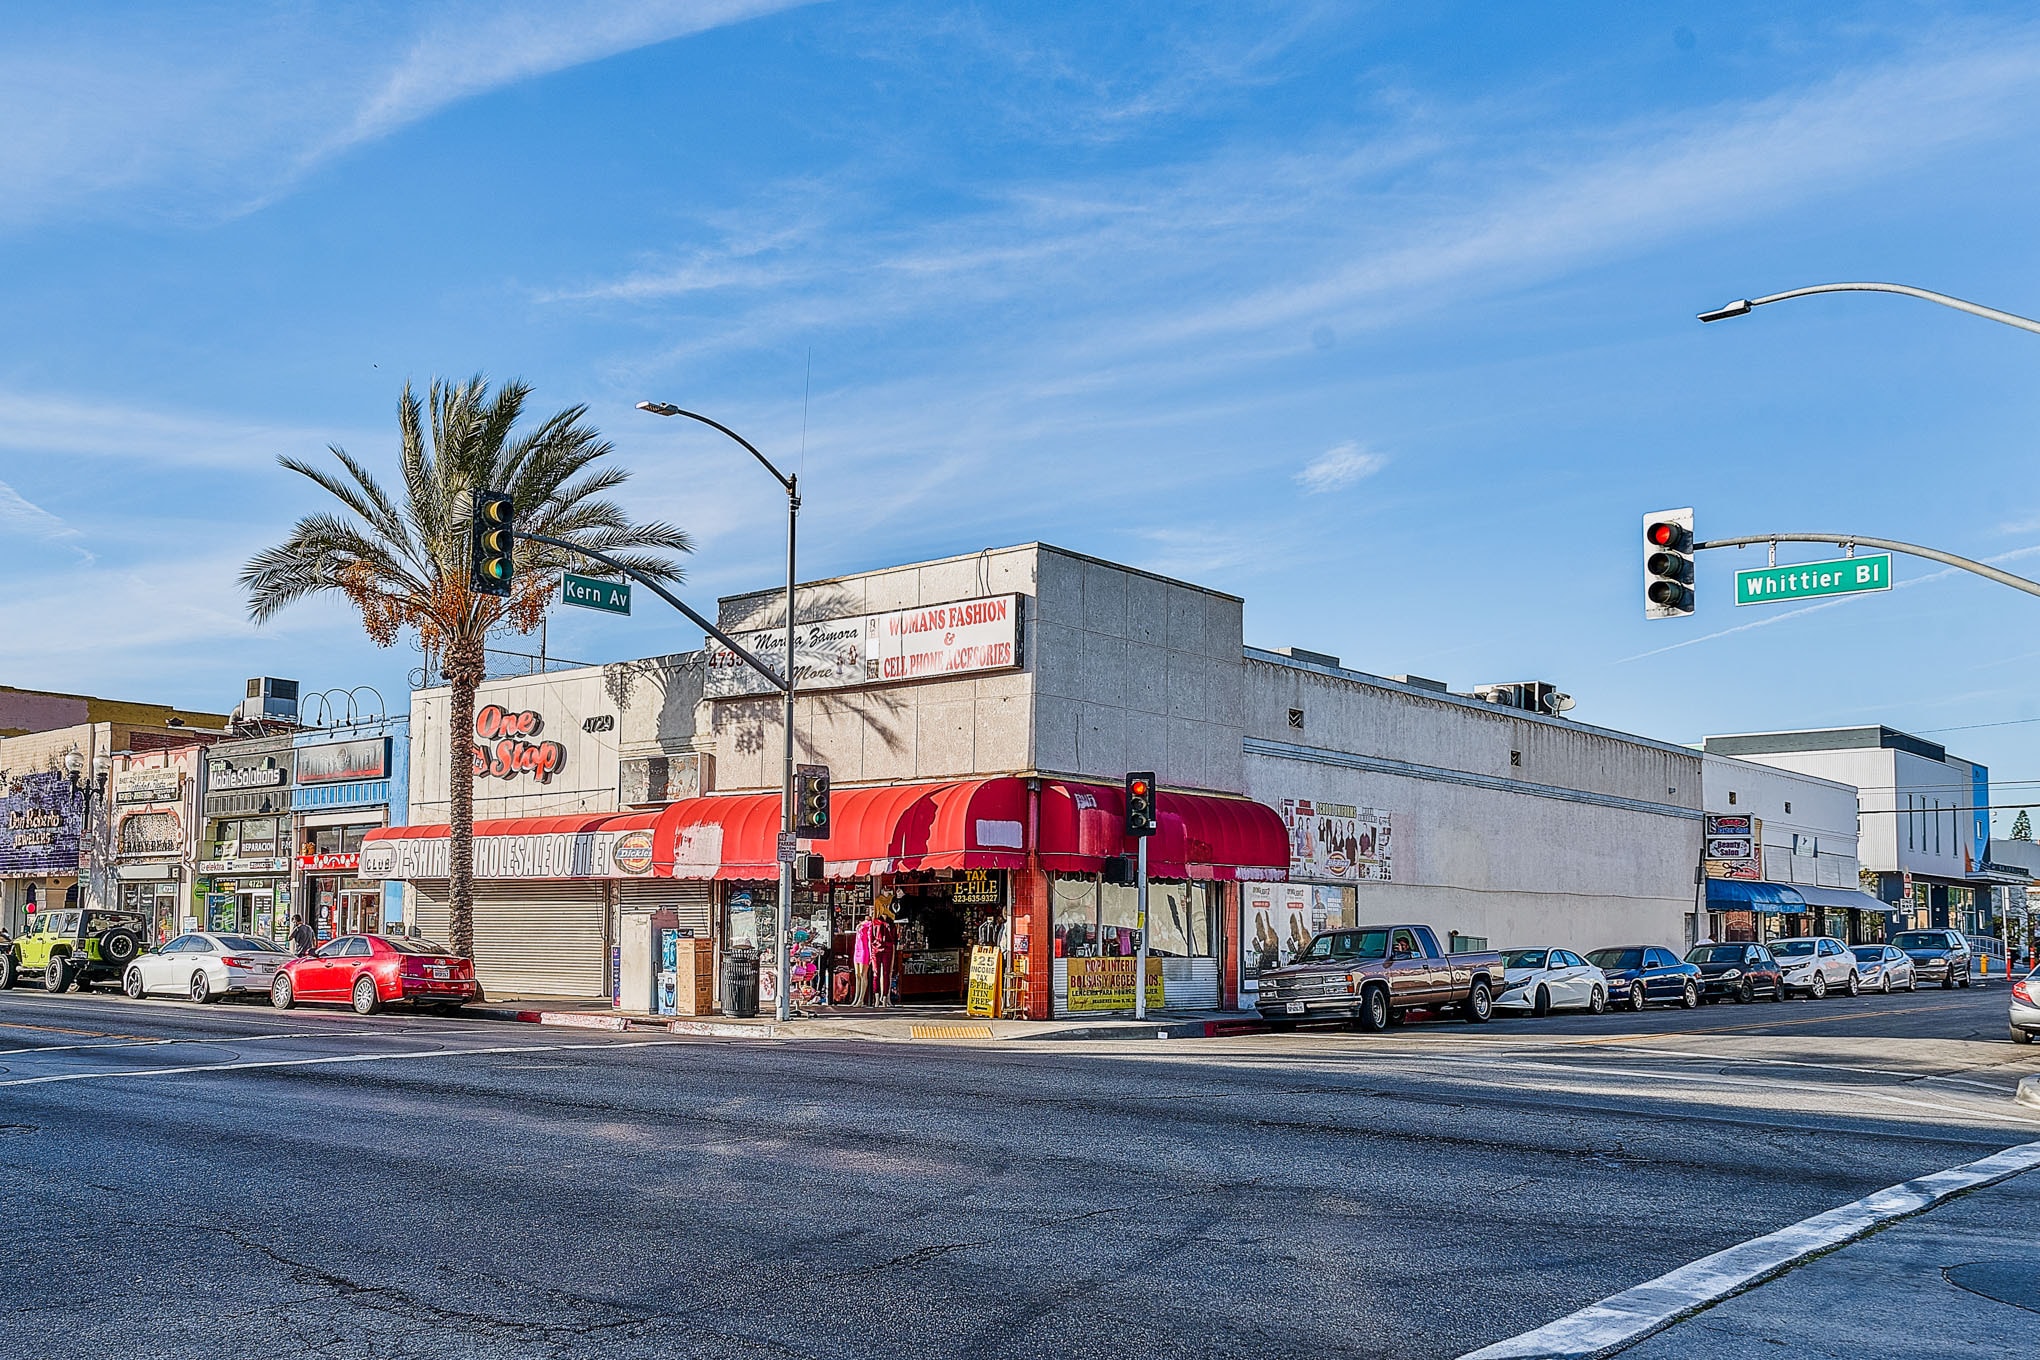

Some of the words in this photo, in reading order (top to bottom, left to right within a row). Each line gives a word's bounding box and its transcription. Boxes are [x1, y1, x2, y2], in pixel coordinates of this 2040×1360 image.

[1747, 571, 1843, 596] Whittier
[1856, 564, 1879, 583] Bl
[566, 580, 601, 603] Kern
[609, 589, 627, 607] Av
[889, 609, 946, 636] WOMANS
[948, 599, 1008, 628] FASHION
[754, 633, 803, 650] Mara
[809, 627, 859, 649] Zamora
[943, 632, 956, 646] &
[883, 656, 908, 679] CELL
[909, 650, 944, 676] PHONE
[793, 665, 833, 681] More
[476, 704, 539, 741] One
[582, 714, 614, 733] 4729
[490, 739, 562, 783] Stop
[210, 768, 237, 788] Mobile
[237, 766, 281, 786] Solutions
[241, 842, 274, 852] REPARACION
[1717, 841, 1740, 849] Beauty
[553, 833, 615, 877] OUTLET
[366, 858, 393, 871] CLUB
[965, 870, 988, 881] TAX
[248, 880, 263, 888] 4725
[953, 880, 998, 895] E-FILE
[952, 894, 998, 903] 323-635-9327
[970, 966, 995, 974] INCOME
[1108, 959, 1137, 972] INTERIO
[976, 974, 988, 982] TAX
[1070, 975, 1102, 988] BOLSAS
[1111, 974, 1161, 987] ACCESIOS.
[973, 989, 989, 997] ITIN
[970, 997, 992, 1006] FREE
